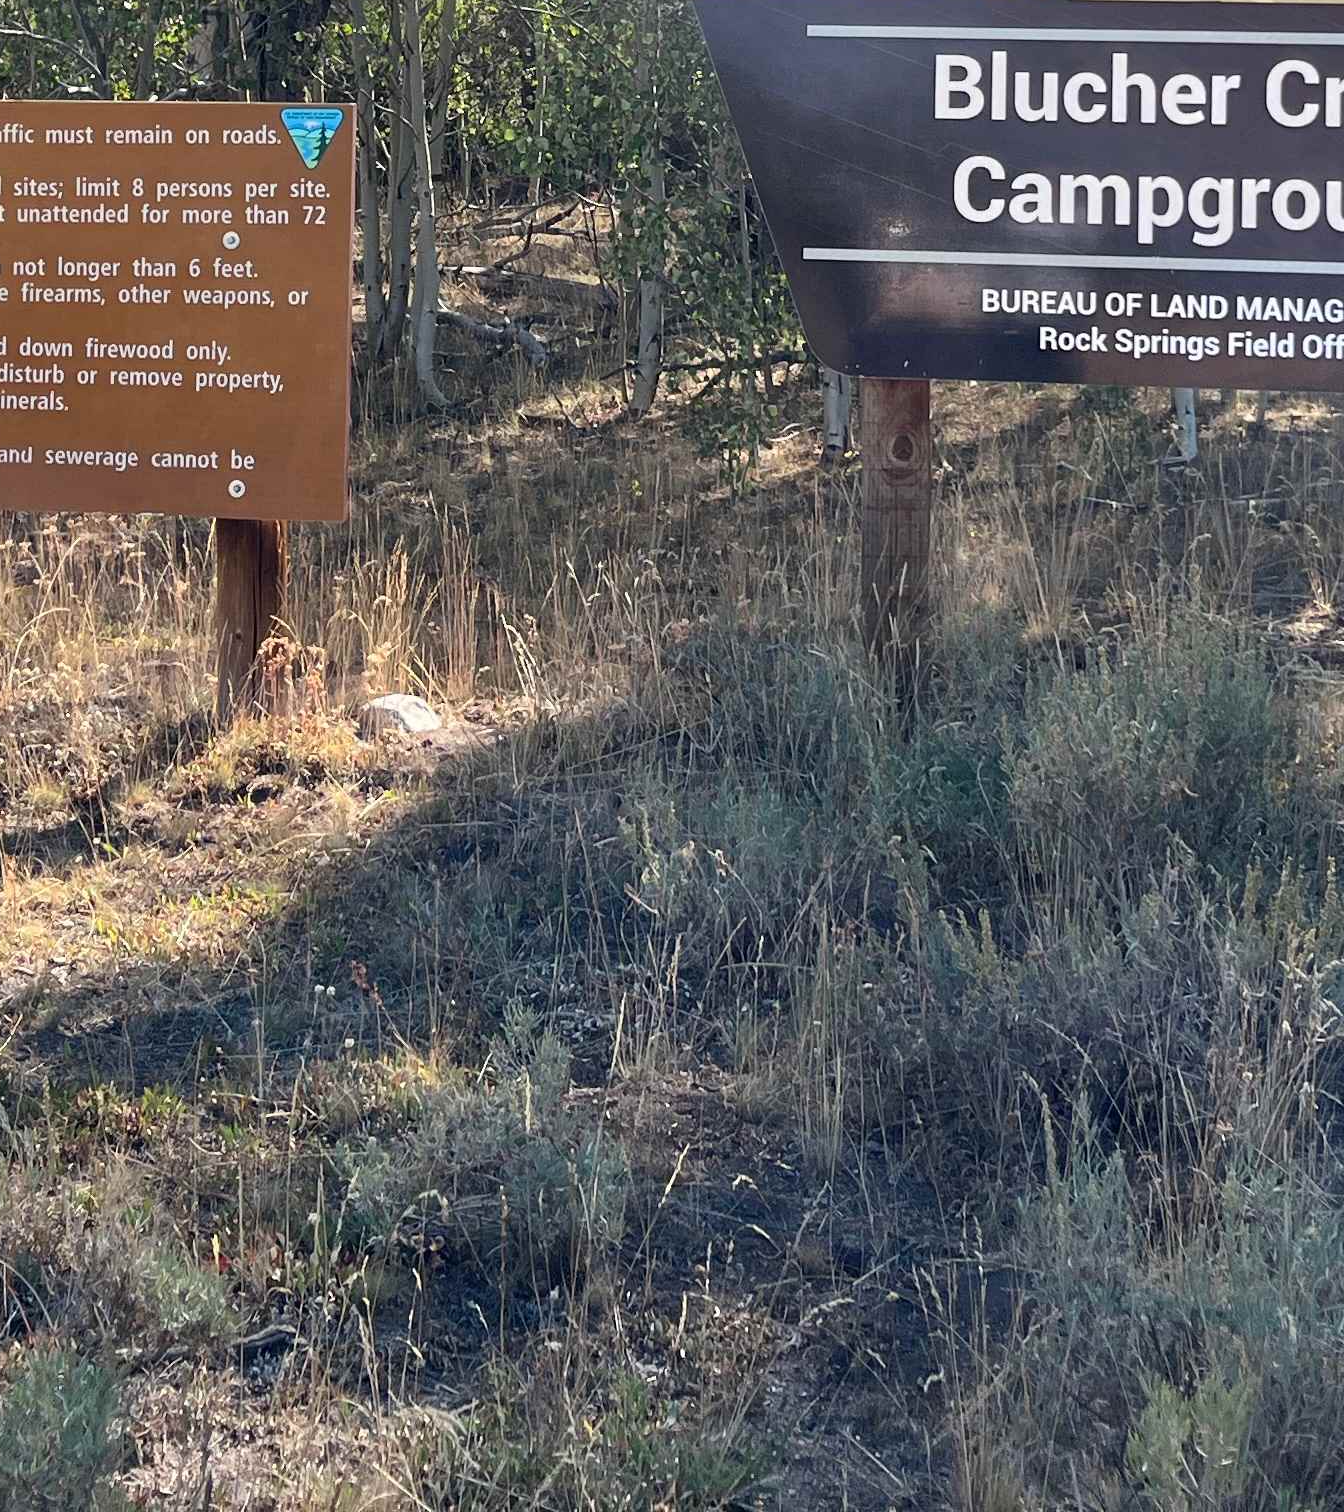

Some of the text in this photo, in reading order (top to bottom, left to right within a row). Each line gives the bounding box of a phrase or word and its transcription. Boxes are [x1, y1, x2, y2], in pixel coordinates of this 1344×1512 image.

[934, 50, 1241, 125] Blucher
[45, 126, 94, 145] must
[105, 124, 173, 145] remain
[185, 129, 210, 145] on
[222, 123, 282, 145] roads.
[13, 176, 64, 200] sites;
[75, 176, 121, 197] limit
[132, 177, 144, 197] 8
[156, 182, 233, 202] persons
[245, 182, 278, 203] per
[289, 177, 331, 199] site.
[16, 203, 129, 224] unattended
[140, 203, 170, 224] for
[182, 209, 233, 225] more
[244, 203, 289, 225] than
[302, 205, 326, 225] 72
[12, 258, 46, 276] not
[57, 256, 121, 282] longer
[132, 256, 176, 277] than
[188, 258, 201, 278] 6
[212, 257, 258, 278] feet.
[20, 281, 106, 306] firearms,
[118, 283, 172, 304] other
[183, 289, 275, 310] weapons,
[287, 290, 309, 306] or
[982, 288, 1097, 316] BUREAU
[1104, 292, 1143, 317] OF
[1150, 293, 1229, 320] LAND
[19, 336, 73, 357] down
[84, 337, 174, 360] firewood
[186, 340, 231, 366] only.
[1039, 326, 1108, 352] Rock
[1114, 328, 1220, 361] Springs
[1227, 330, 1295, 358] Field
[77, 369, 98, 385] or
[110, 370, 183, 387] remove
[195, 370, 284, 394] property,
[45, 449, 139, 472] sewerage
[151, 451, 219, 470] cannot
[230, 448, 255, 470] be
